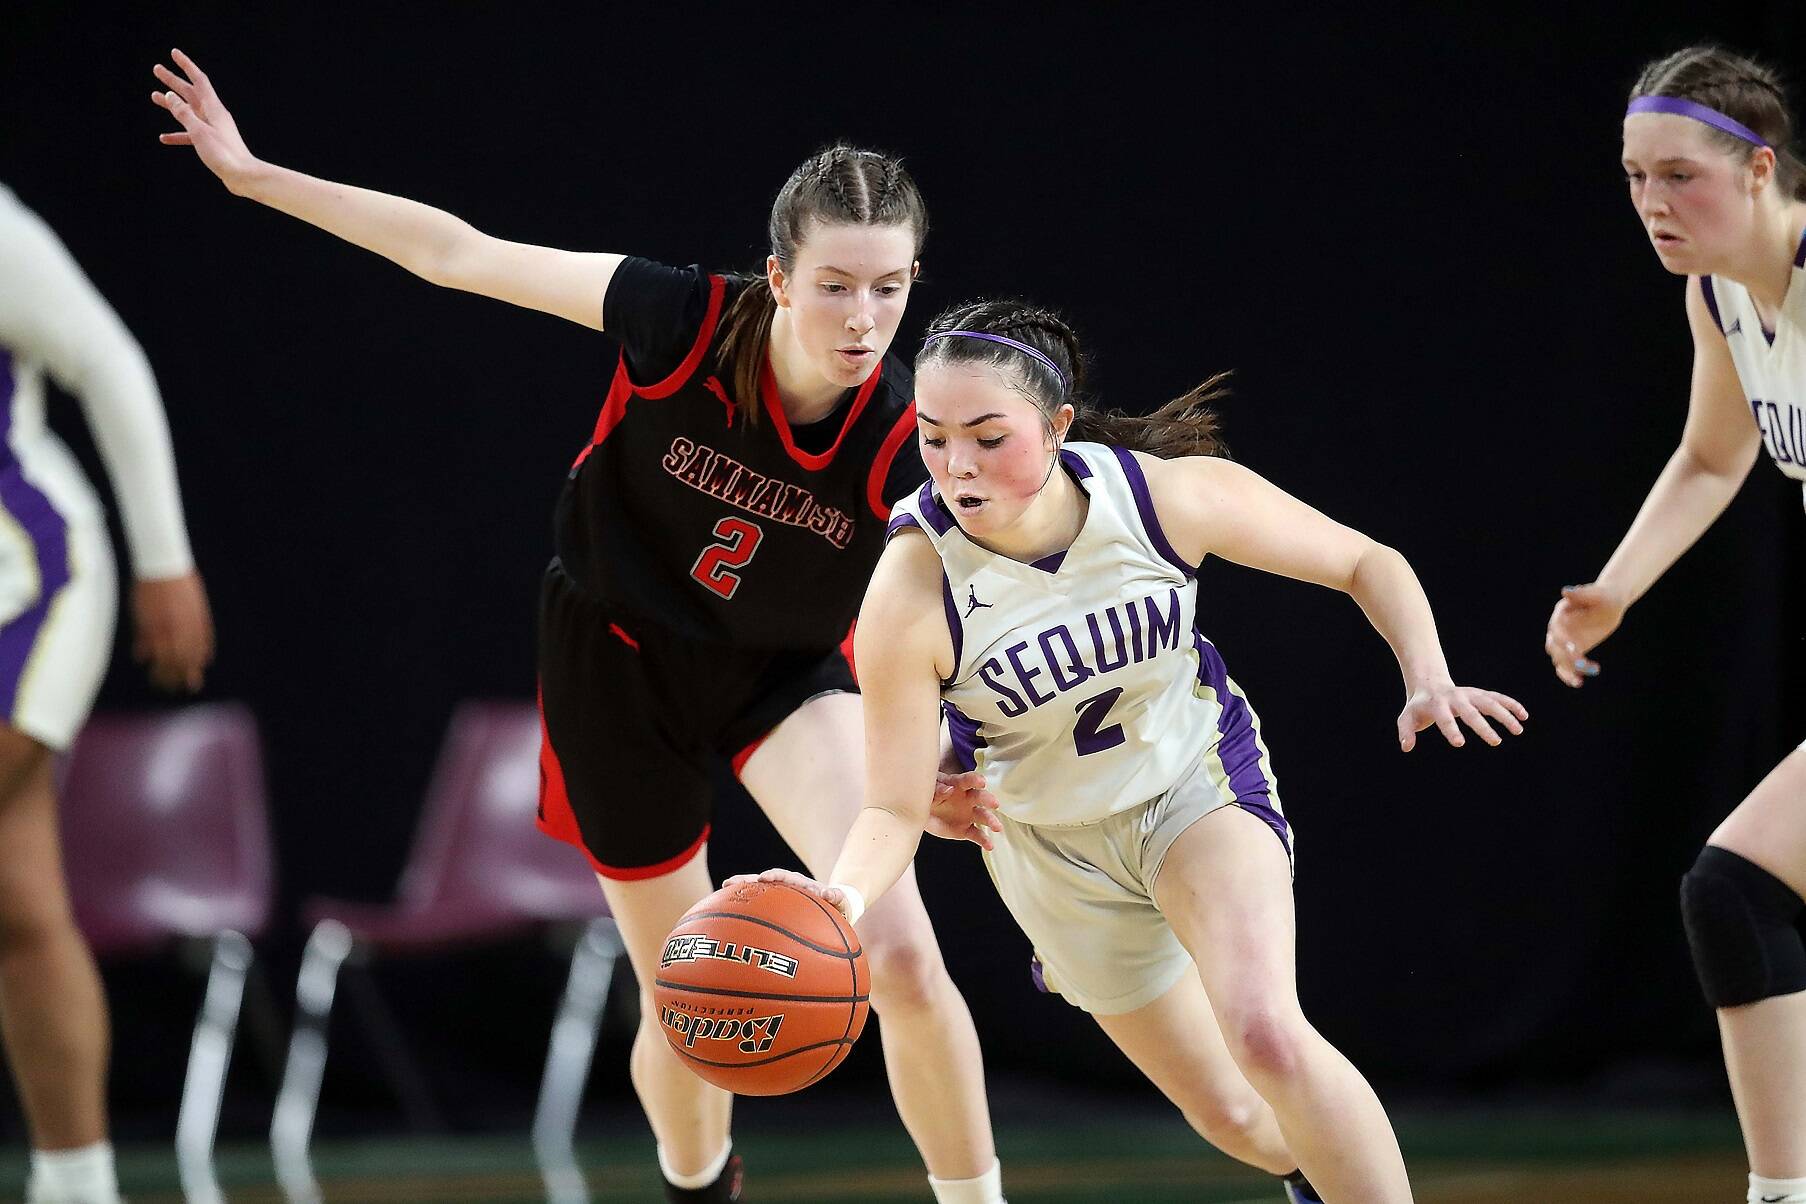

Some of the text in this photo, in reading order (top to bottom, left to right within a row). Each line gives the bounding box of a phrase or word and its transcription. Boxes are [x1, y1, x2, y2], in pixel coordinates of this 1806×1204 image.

[662, 437, 855, 550] SAMMAMISH
[690, 516, 764, 600] 2
[978, 588, 1181, 718] SEQUIM
[1073, 687, 1126, 757] 2
[662, 1004, 785, 1053] Baden
